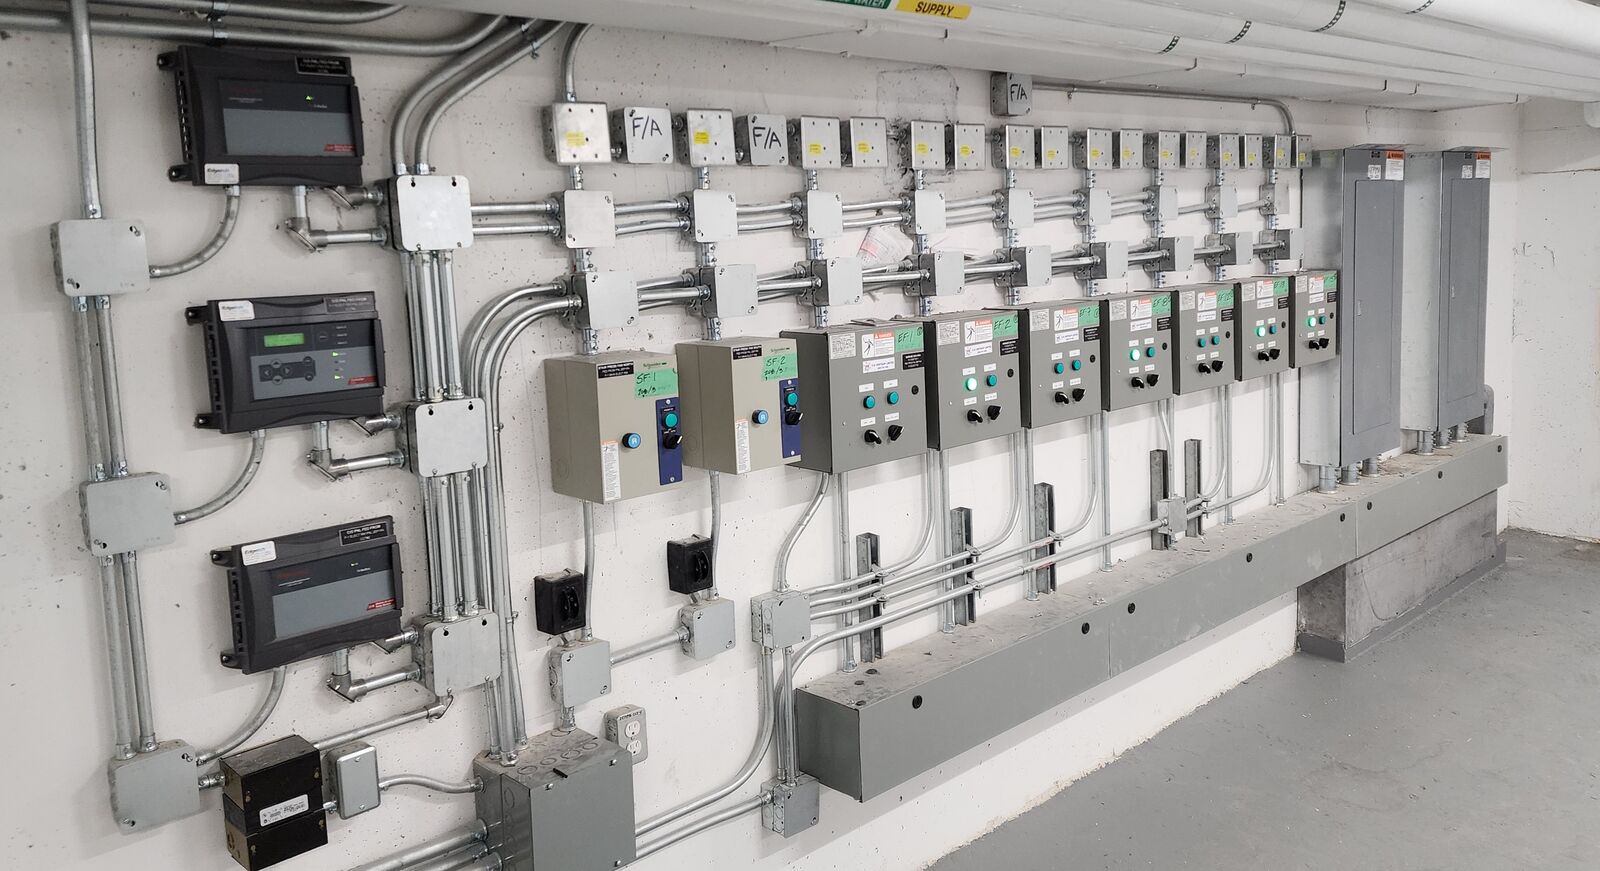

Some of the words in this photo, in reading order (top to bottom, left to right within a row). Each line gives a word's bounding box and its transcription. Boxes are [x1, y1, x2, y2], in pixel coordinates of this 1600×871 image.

[915, 1, 954, 17] SUPPLY
[1010, 83, 1028, 102] F/A
[631, 115, 663, 140] F/A
[752, 126, 782, 150] F/A
